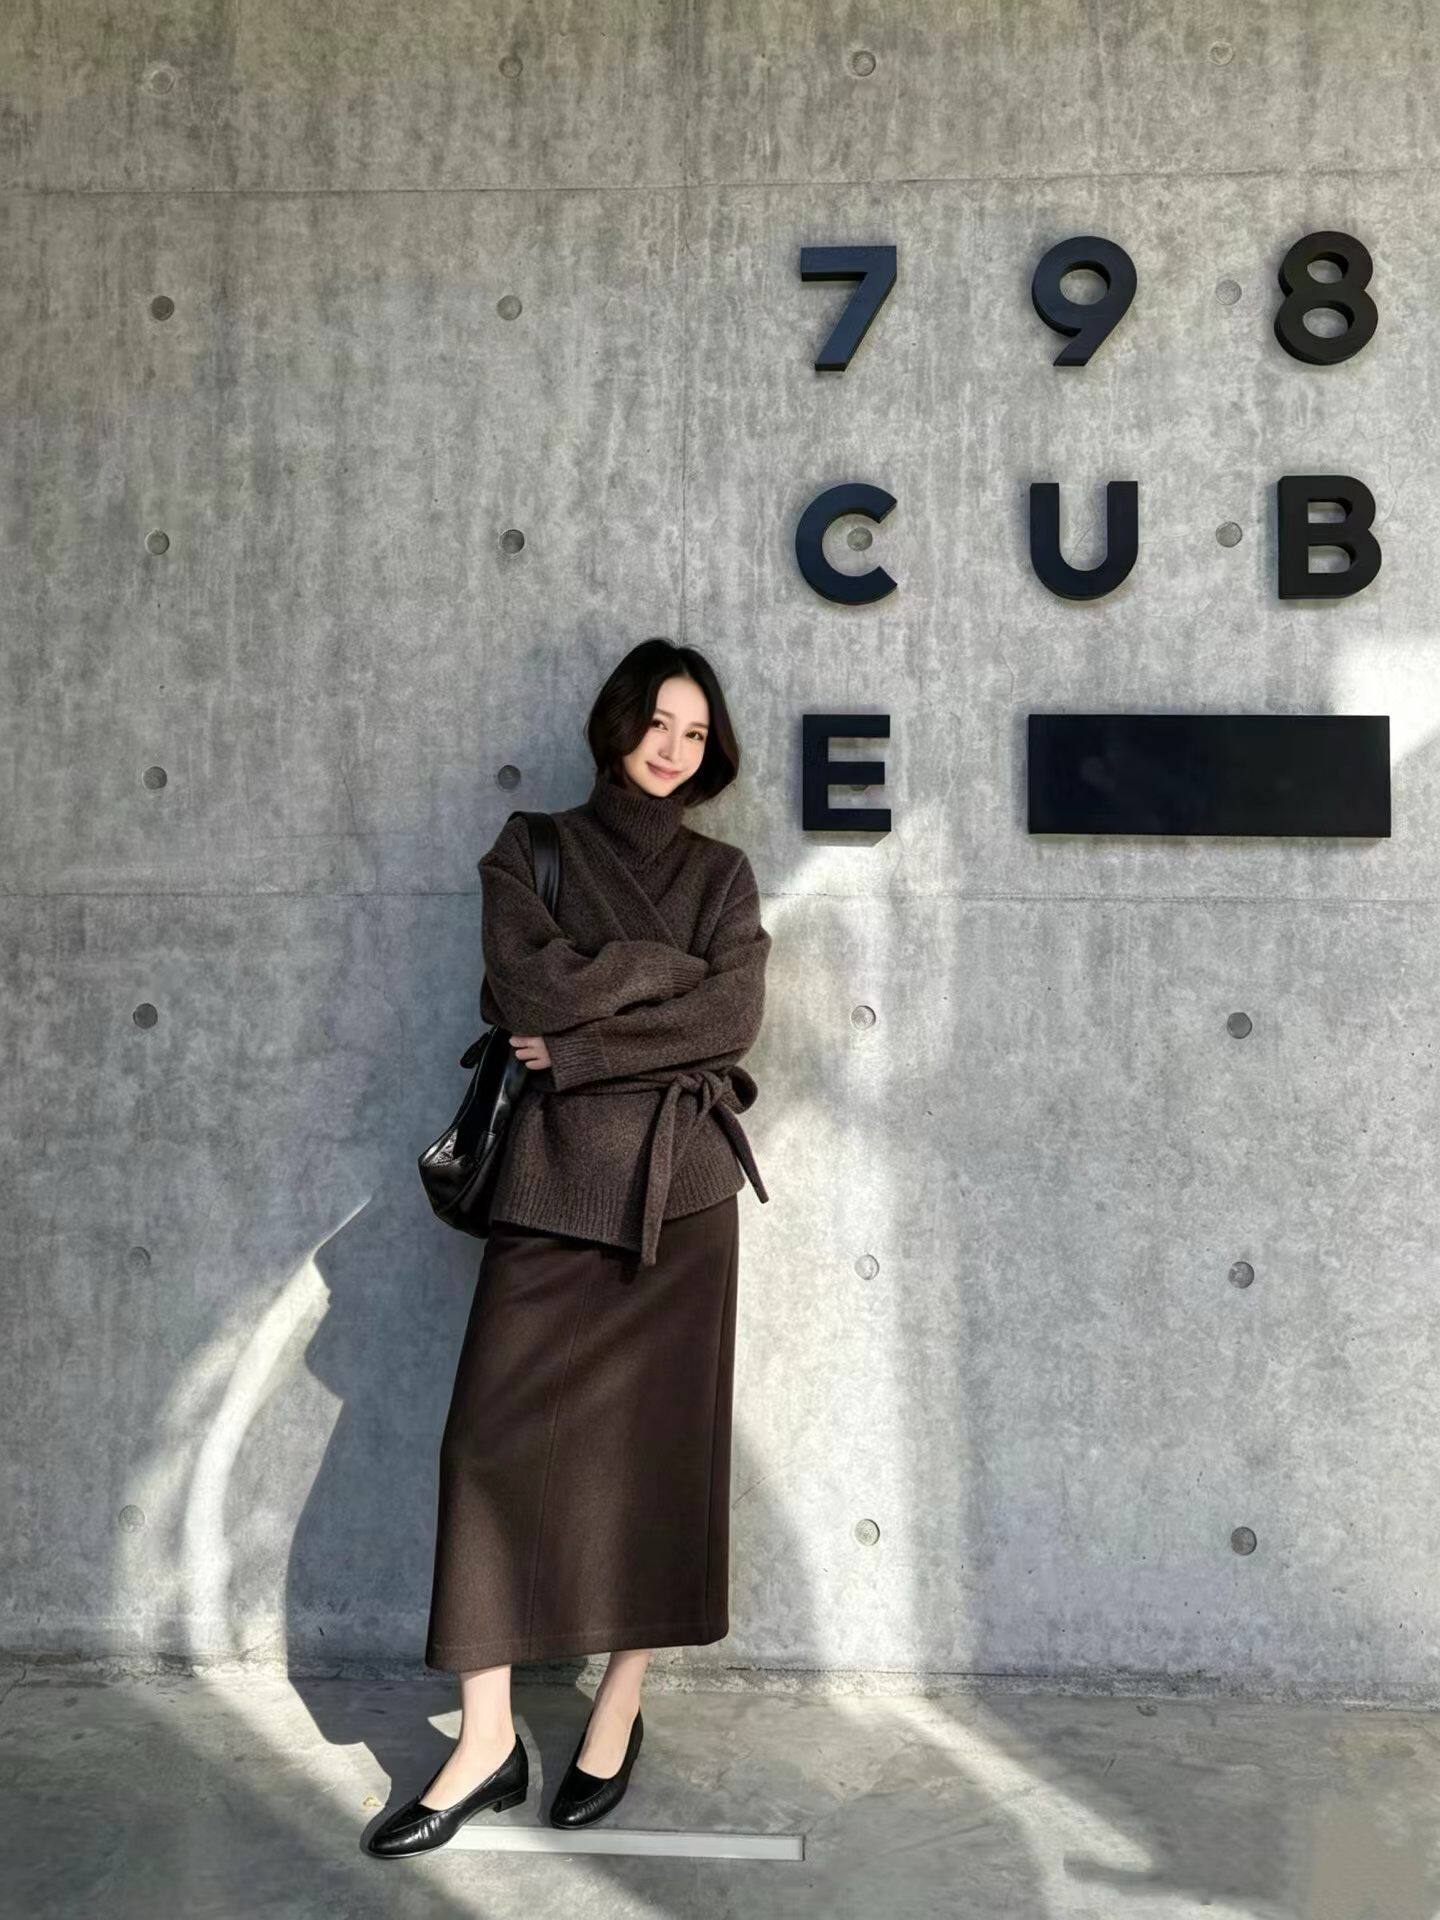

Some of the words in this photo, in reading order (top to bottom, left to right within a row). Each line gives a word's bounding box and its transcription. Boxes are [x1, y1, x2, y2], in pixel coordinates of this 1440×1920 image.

[800, 230, 1379, 372] 798
[795, 475, 1382, 606] CUB
[801, 714, 892, 832] E
